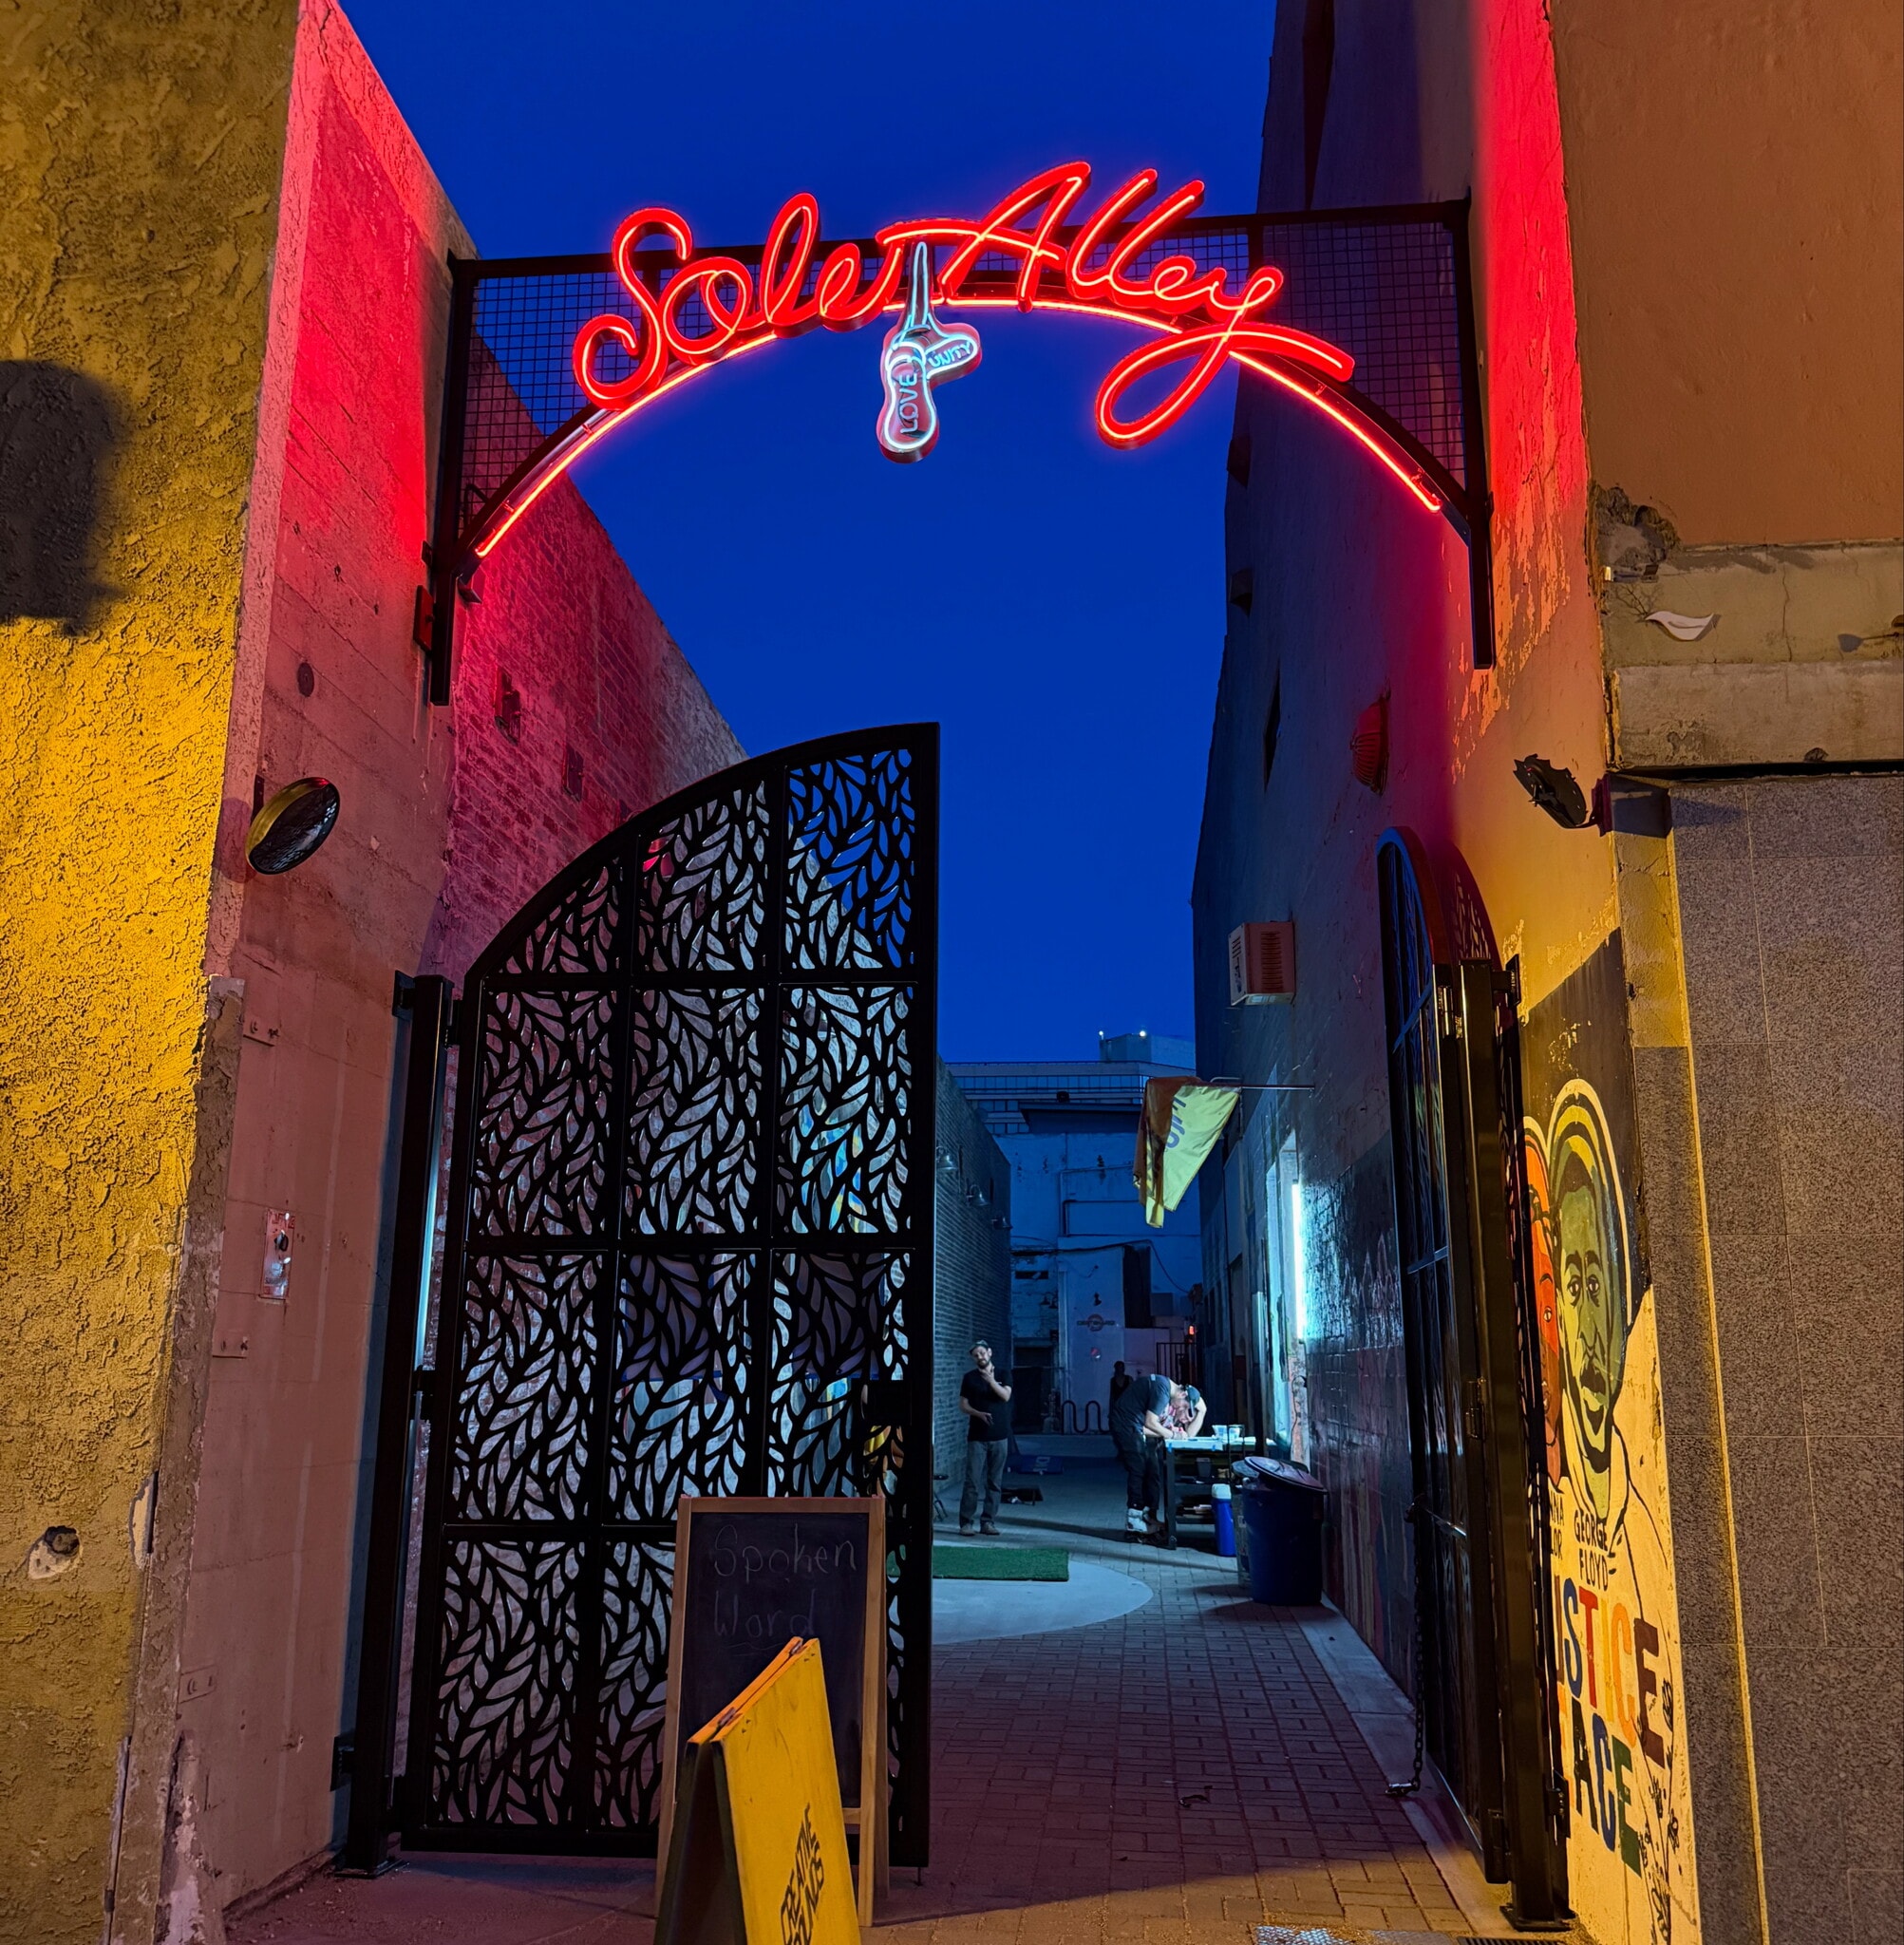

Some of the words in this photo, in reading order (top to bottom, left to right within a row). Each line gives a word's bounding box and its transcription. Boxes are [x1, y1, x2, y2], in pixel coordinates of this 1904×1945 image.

[573, 193, 903, 410] Sole
[876, 161, 1354, 449] Alley
[928, 341, 971, 368] UNITY
[898, 373, 919, 434] LOVE
[714, 1522, 857, 1584] Spoken
[1574, 1509, 1608, 1551] GEORGE
[1578, 1547, 1608, 1592] FLOYD
[714, 1588, 817, 1637] Word
[1555, 1575, 1665, 1769] STICE
[1557, 1681, 1643, 1879] ACE
